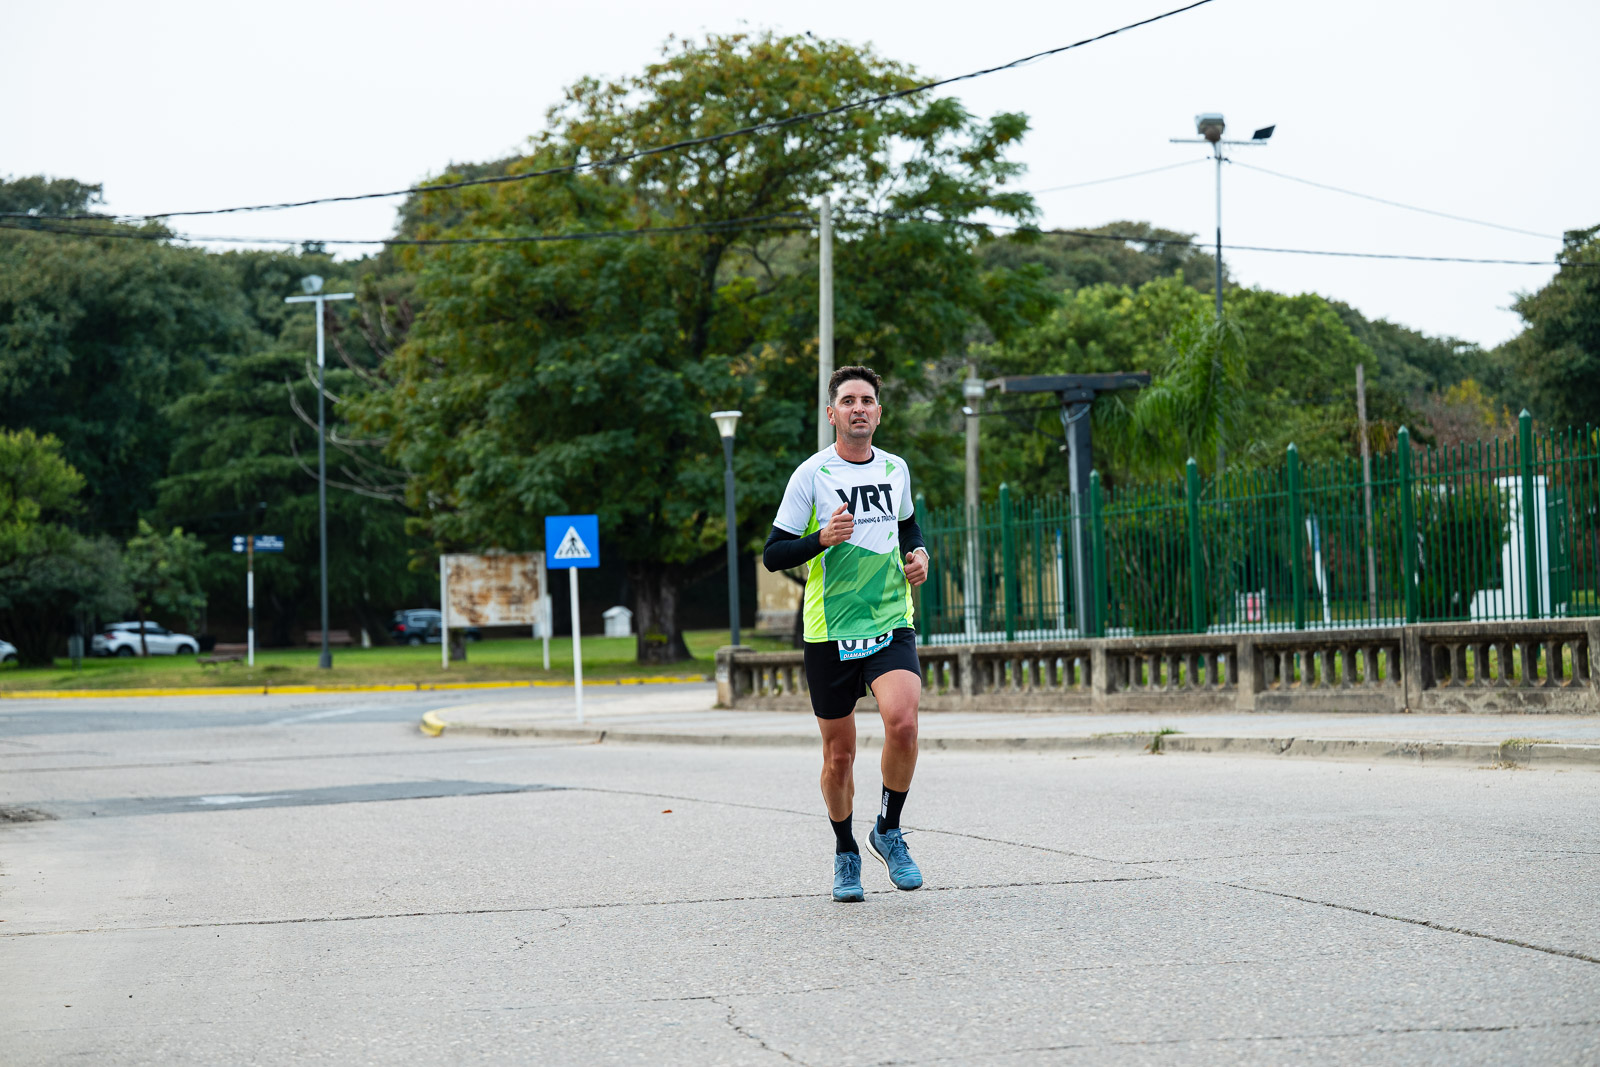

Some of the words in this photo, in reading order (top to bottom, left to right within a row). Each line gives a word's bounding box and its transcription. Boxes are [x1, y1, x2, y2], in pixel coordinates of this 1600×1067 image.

[835, 483, 893, 517] VRT
[857, 516, 877, 525] RUNNING
[843, 649, 873, 659] DIAMANTE
